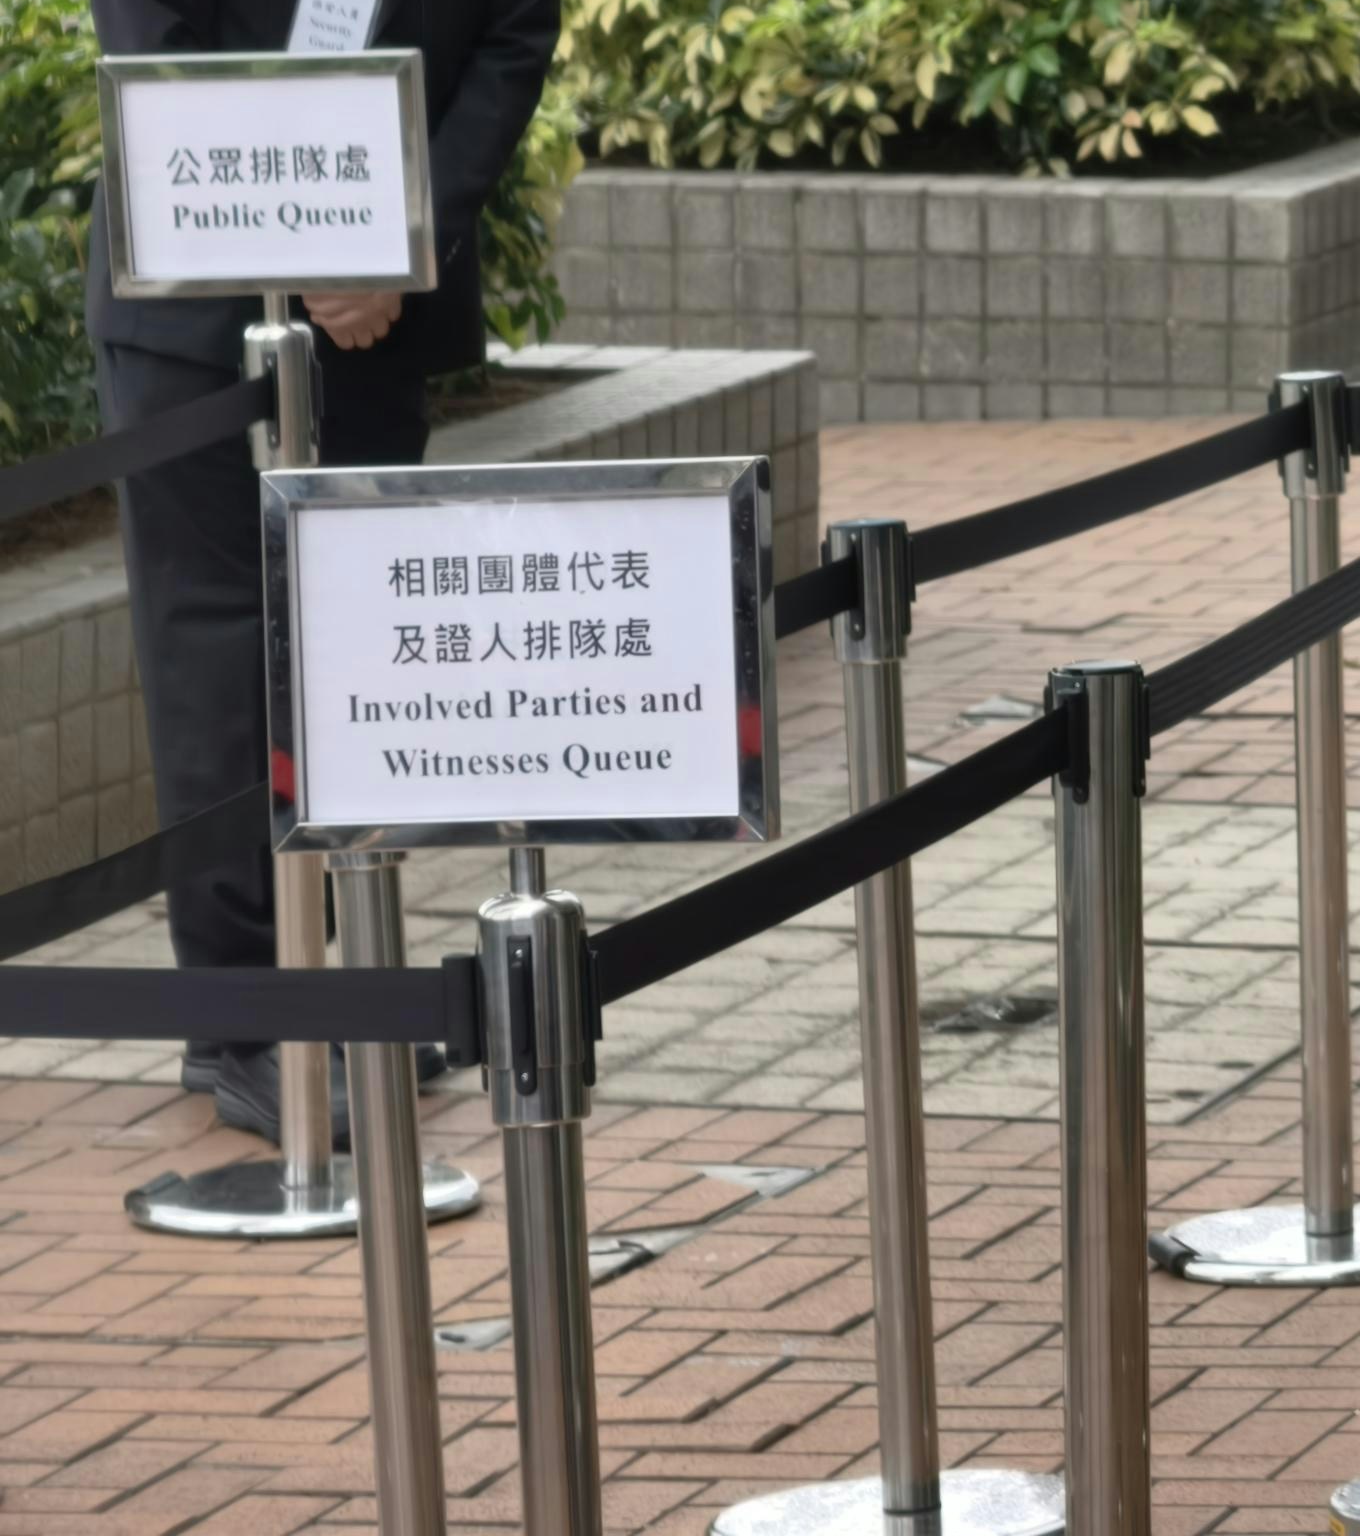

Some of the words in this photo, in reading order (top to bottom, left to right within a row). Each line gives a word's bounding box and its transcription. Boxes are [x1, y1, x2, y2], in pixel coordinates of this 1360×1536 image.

[166, 144, 371, 187] 公眾排隊處
[172, 203, 266, 231] Public
[276, 201, 374, 233] Queue
[387, 549, 651, 599] 相關團體代表
[391, 617, 654, 665] 及證人排隊處
[347, 689, 494, 724] Involved
[507, 686, 628, 719] Parties
[640, 683, 704, 714] and
[380, 748, 551, 778] Witnesses
[562, 743, 673, 780] Queue
